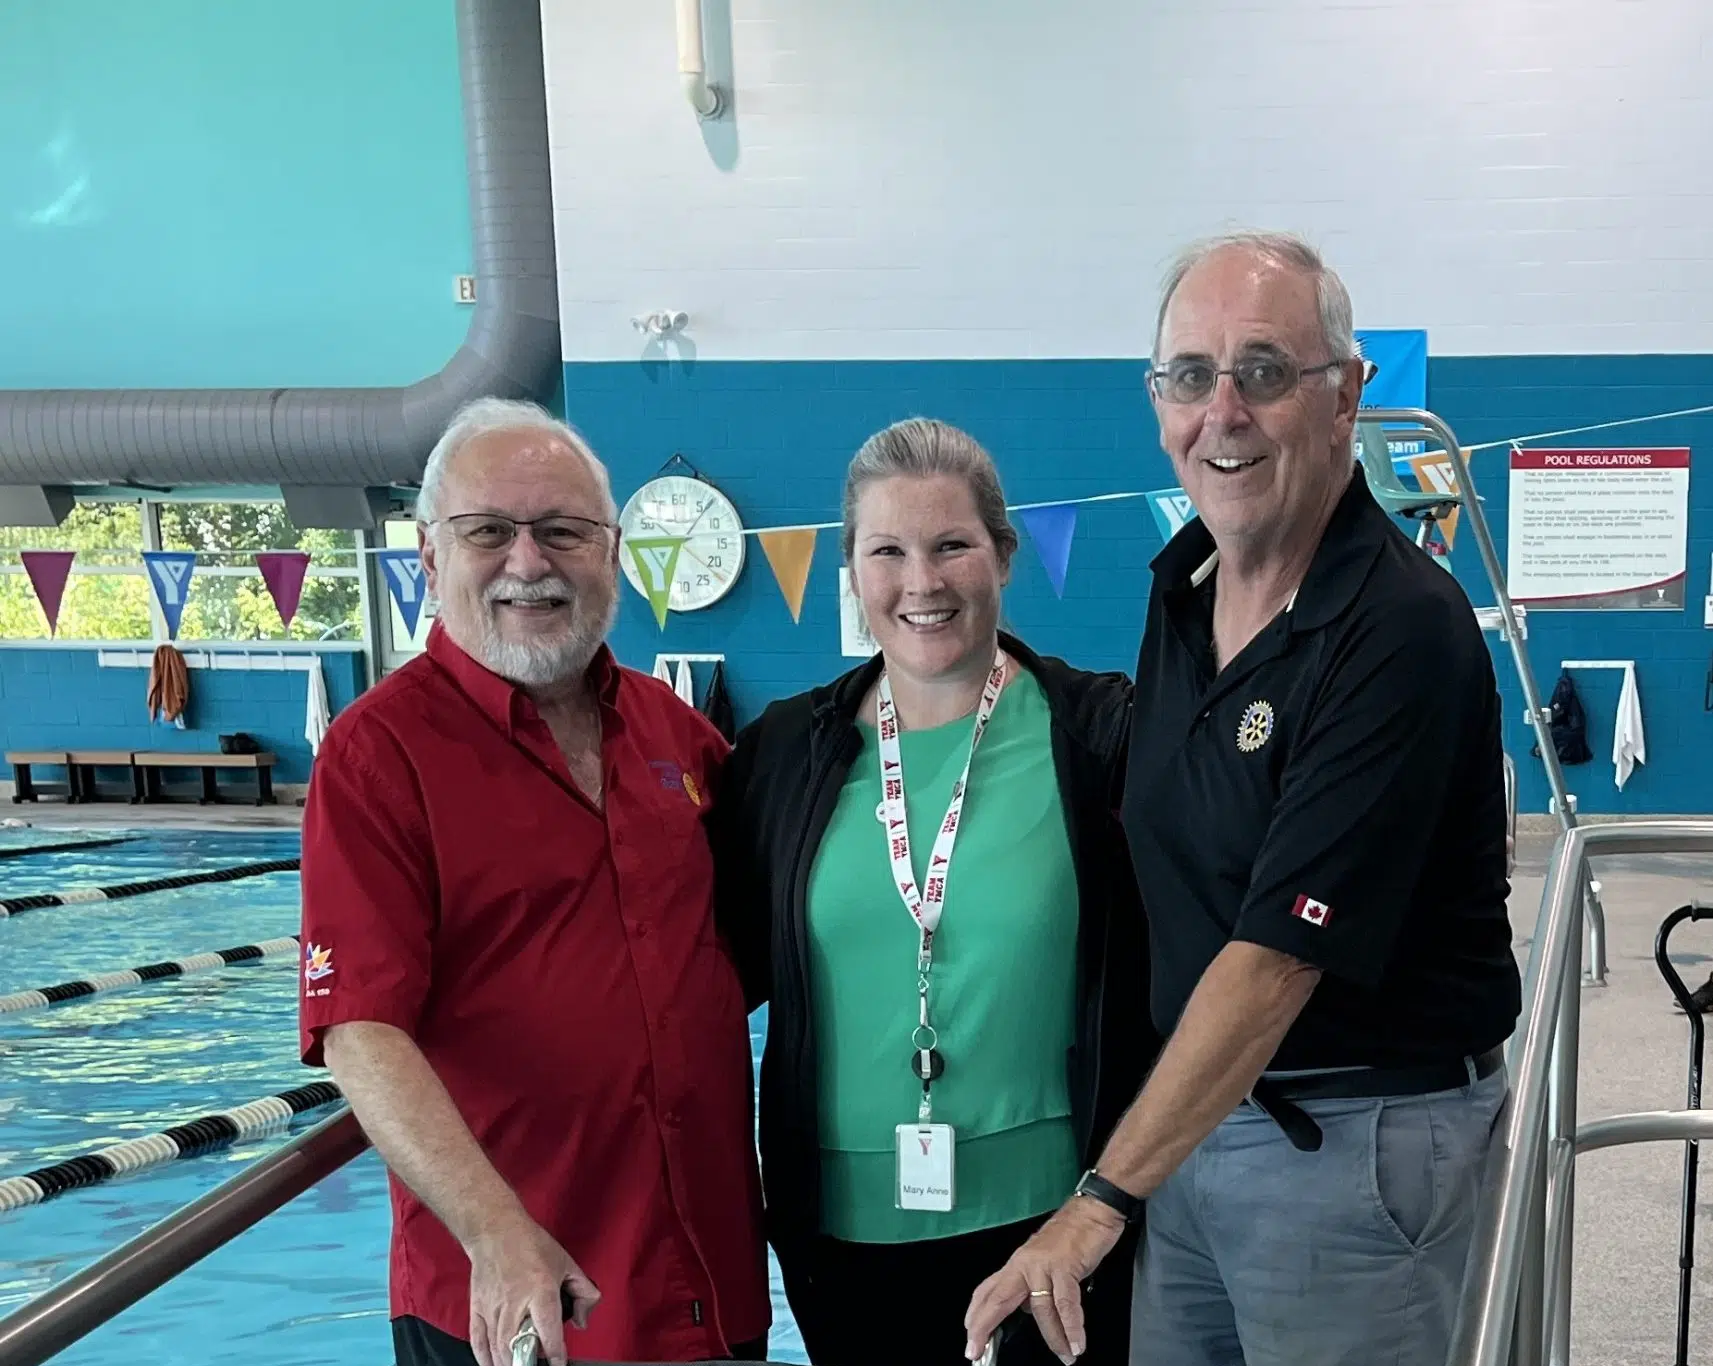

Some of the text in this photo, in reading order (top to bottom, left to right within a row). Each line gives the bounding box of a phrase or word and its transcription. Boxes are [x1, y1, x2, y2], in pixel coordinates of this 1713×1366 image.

[460, 277, 476, 300] EX
[1544, 454, 1652, 466] POOL REGULATIONS
[671, 494, 686, 505] 60
[696, 501, 704, 513] 5
[709, 518, 720, 529] 10
[716, 538, 728, 550] 15
[707, 556, 722, 568] 20
[697, 575, 710, 586] 25
[926, 877, 937, 903] TEAM
[934, 876, 945, 903] YMCA
[903, 1185, 949, 1196] Mary Anne
